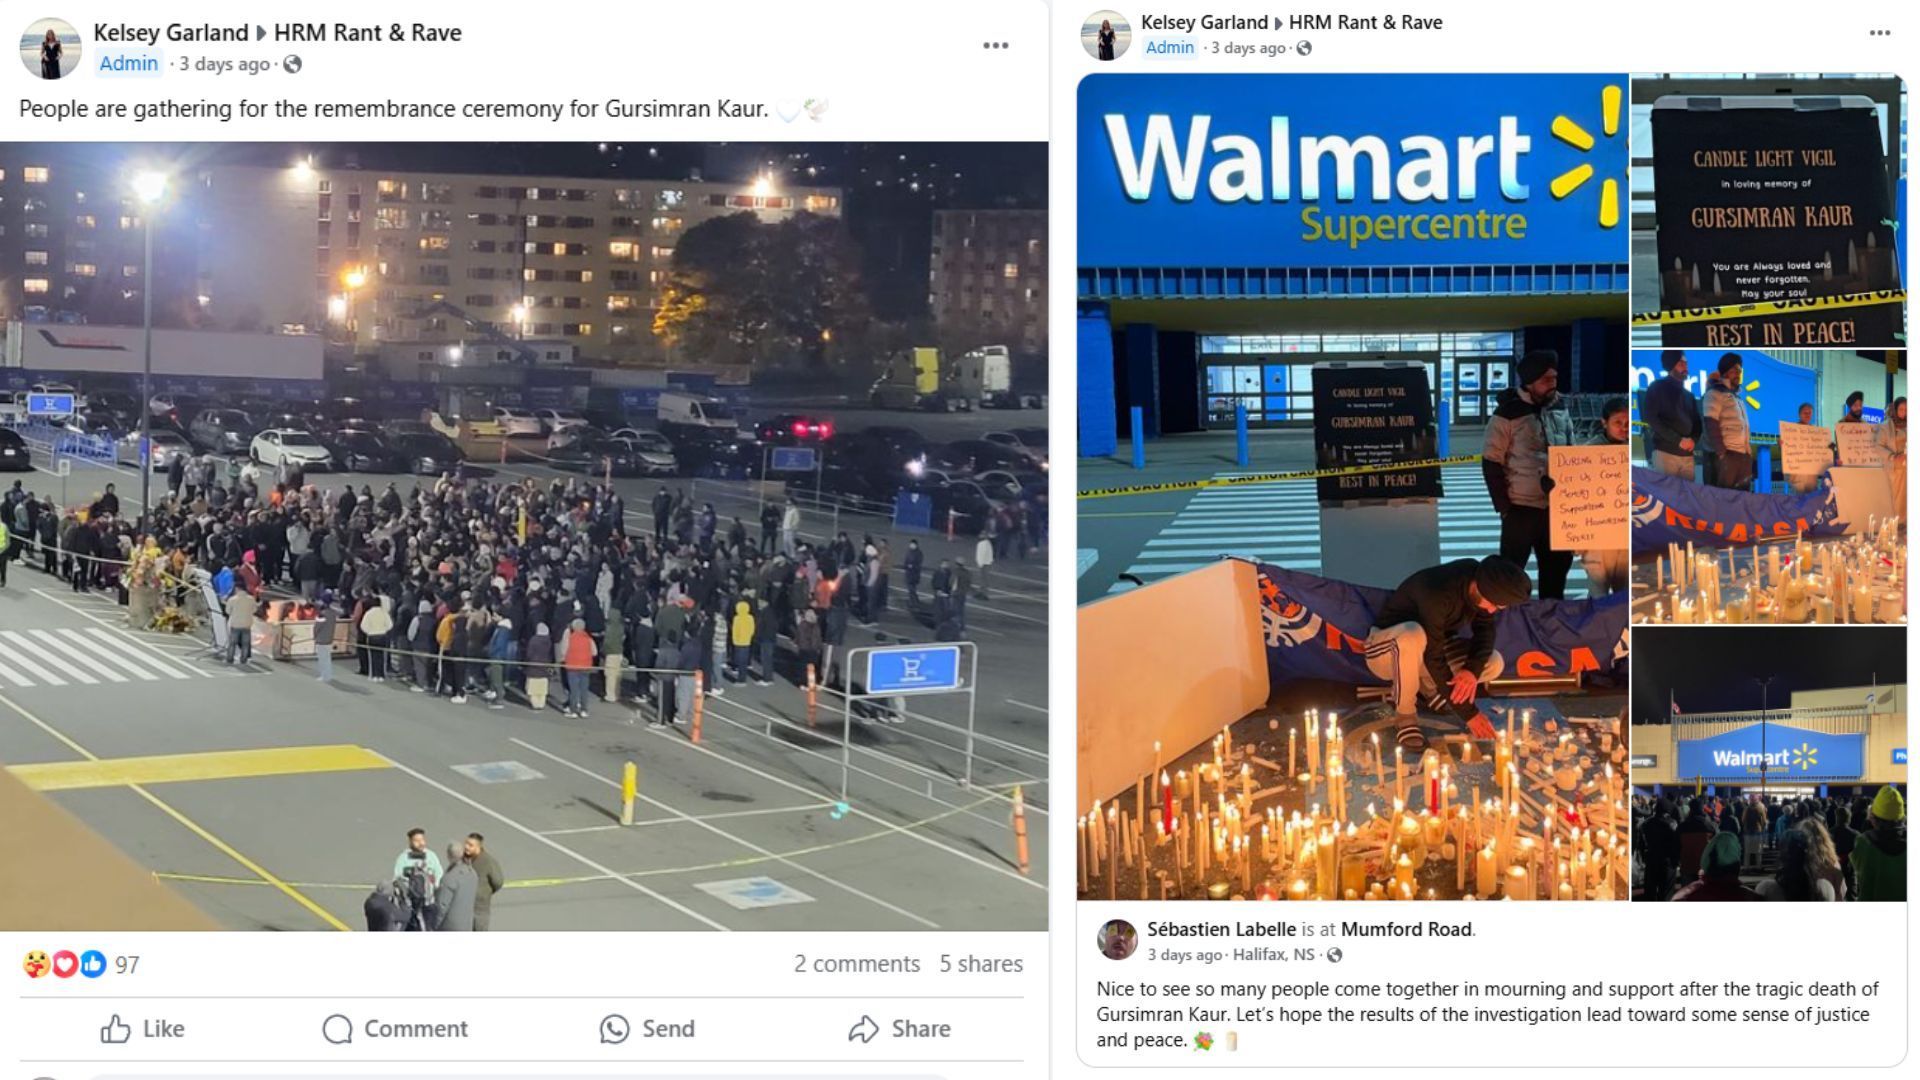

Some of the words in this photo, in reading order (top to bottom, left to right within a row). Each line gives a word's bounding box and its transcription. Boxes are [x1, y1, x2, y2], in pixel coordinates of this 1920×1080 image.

[1141, 14, 1197, 34] Kelsey
[1200, 14, 1269, 30] Garland
[1289, 14, 1332, 30] HRM
[1337, 14, 1379, 30] Rant
[1382, 14, 1397, 30] &
[1401, 14, 1444, 30] Rave
[94, 22, 161, 47] Kelsey
[166, 22, 249, 42] Garland
[274, 22, 327, 42] HRM
[334, 22, 383, 42] Rant
[388, 22, 406, 42] &
[411, 22, 463, 42] Rave
[1145, 39, 1195, 55] Admin
[1211, 40, 1220, 54] 3
[1223, 41, 1256, 58] days
[1259, 44, 1287, 58] ago
[99, 53, 159, 72] Admin
[179, 55, 190, 71] 3
[194, 55, 234, 76] days
[238, 60, 271, 76] ago
[19, 98, 89, 123] People
[94, 103, 128, 118] are
[133, 98, 232, 123] gathering
[238, 98, 269, 118] for
[273, 98, 308, 118] the
[314, 98, 457, 118] remembrance
[461, 103, 565, 123] ceremony
[569, 98, 600, 118] for
[604, 98, 711, 118] Gursimran
[717, 98, 769, 118] Kaur.
[1104, 114, 1531, 200] Walmart
[1693, 150, 1748, 168] CANDLE
[1755, 150, 1794, 167] LIGHT
[1802, 149, 1837, 166] VIGIL
[1733, 179, 1761, 191] loving
[1764, 180, 1798, 190] memory
[1801, 178, 1812, 188] of
[1691, 206, 1796, 229] GURSIMRAN
[1805, 205, 1854, 227] KAUR
[1301, 206, 1527, 249] Supercentre
[1712, 261, 1731, 272] You
[1733, 262, 1749, 271] are
[1753, 261, 1784, 273] Always
[1786, 261, 1811, 270] loved
[1814, 260, 1832, 270] and
[1735, 275, 1761, 285] never
[1741, 289, 1759, 299] May
[1762, 289, 1785, 299] your
[1788, 288, 1808, 298] soul
[1705, 322, 1753, 347] REST
[1763, 322, 1782, 345] IN
[1792, 320, 1856, 344] PEACE!
[1713, 748, 1790, 767] Walmart
[1147, 921, 1231, 937] Sébastien
[1236, 921, 1298, 937] Labelle
[1301, 921, 1315, 937] is
[1319, 922, 1337, 937] at
[1341, 921, 1423, 937] Mumford
[1428, 921, 1476, 937] Road.
[114, 955, 140, 975] 97
[794, 953, 807, 973] 2
[813, 955, 921, 973] comments
[939, 953, 952, 973] 5
[957, 954, 1024, 973] shares
[1148, 947, 1157, 961] 3
[1160, 947, 1193, 965] days
[1195, 951, 1223, 965] ago
[1233, 946, 1289, 963] Halifax,
[1293, 947, 1316, 961] NS
[1097, 980, 1135, 997] Nice
[1139, 981, 1158, 997] to
[1162, 984, 1191, 997] see
[1195, 984, 1215, 997] so
[1220, 984, 1267, 1001] many
[1271, 980, 1330, 1001] people
[1334, 984, 1382, 997] come
[1385, 980, 1460, 1001] together
[1464, 980, 1480, 997] in
[1484, 980, 1567, 1001] mourning
[1571, 980, 1604, 997] and
[1608, 982, 1675, 1001] support
[1679, 980, 1719, 997] after
[1722, 980, 1752, 997] the
[1755, 980, 1804, 1001] tragic
[1808, 980, 1857, 997] death
[1861, 980, 1880, 997] of
[1096, 1006, 1184, 1022] Gursimran
[1188, 1006, 1232, 1022] Kaur.
[1279, 1006, 1323, 1026] hope
[1326, 1006, 1355, 1022] the
[1360, 1006, 1415, 1022] results
[1418, 1006, 1438, 1022] of
[1441, 1006, 1470, 1022] the
[1474, 1005, 1582, 1026] investigation
[1587, 1006, 1622, 1022] lead
[1626, 1006, 1686, 1022] toward
[1691, 1009, 1738, 1022] some
[1742, 1009, 1790, 1022] sense
[1794, 1006, 1812, 1022] of
[1813, 1006, 1871, 1026] justice
[143, 1018, 186, 1038] Like
[364, 1018, 469, 1038] Comment
[643, 1018, 695, 1038] Send
[892, 1018, 952, 1038] Share
[1096, 1031, 1128, 1048] and
[1133, 1035, 1188, 1052] peace.
